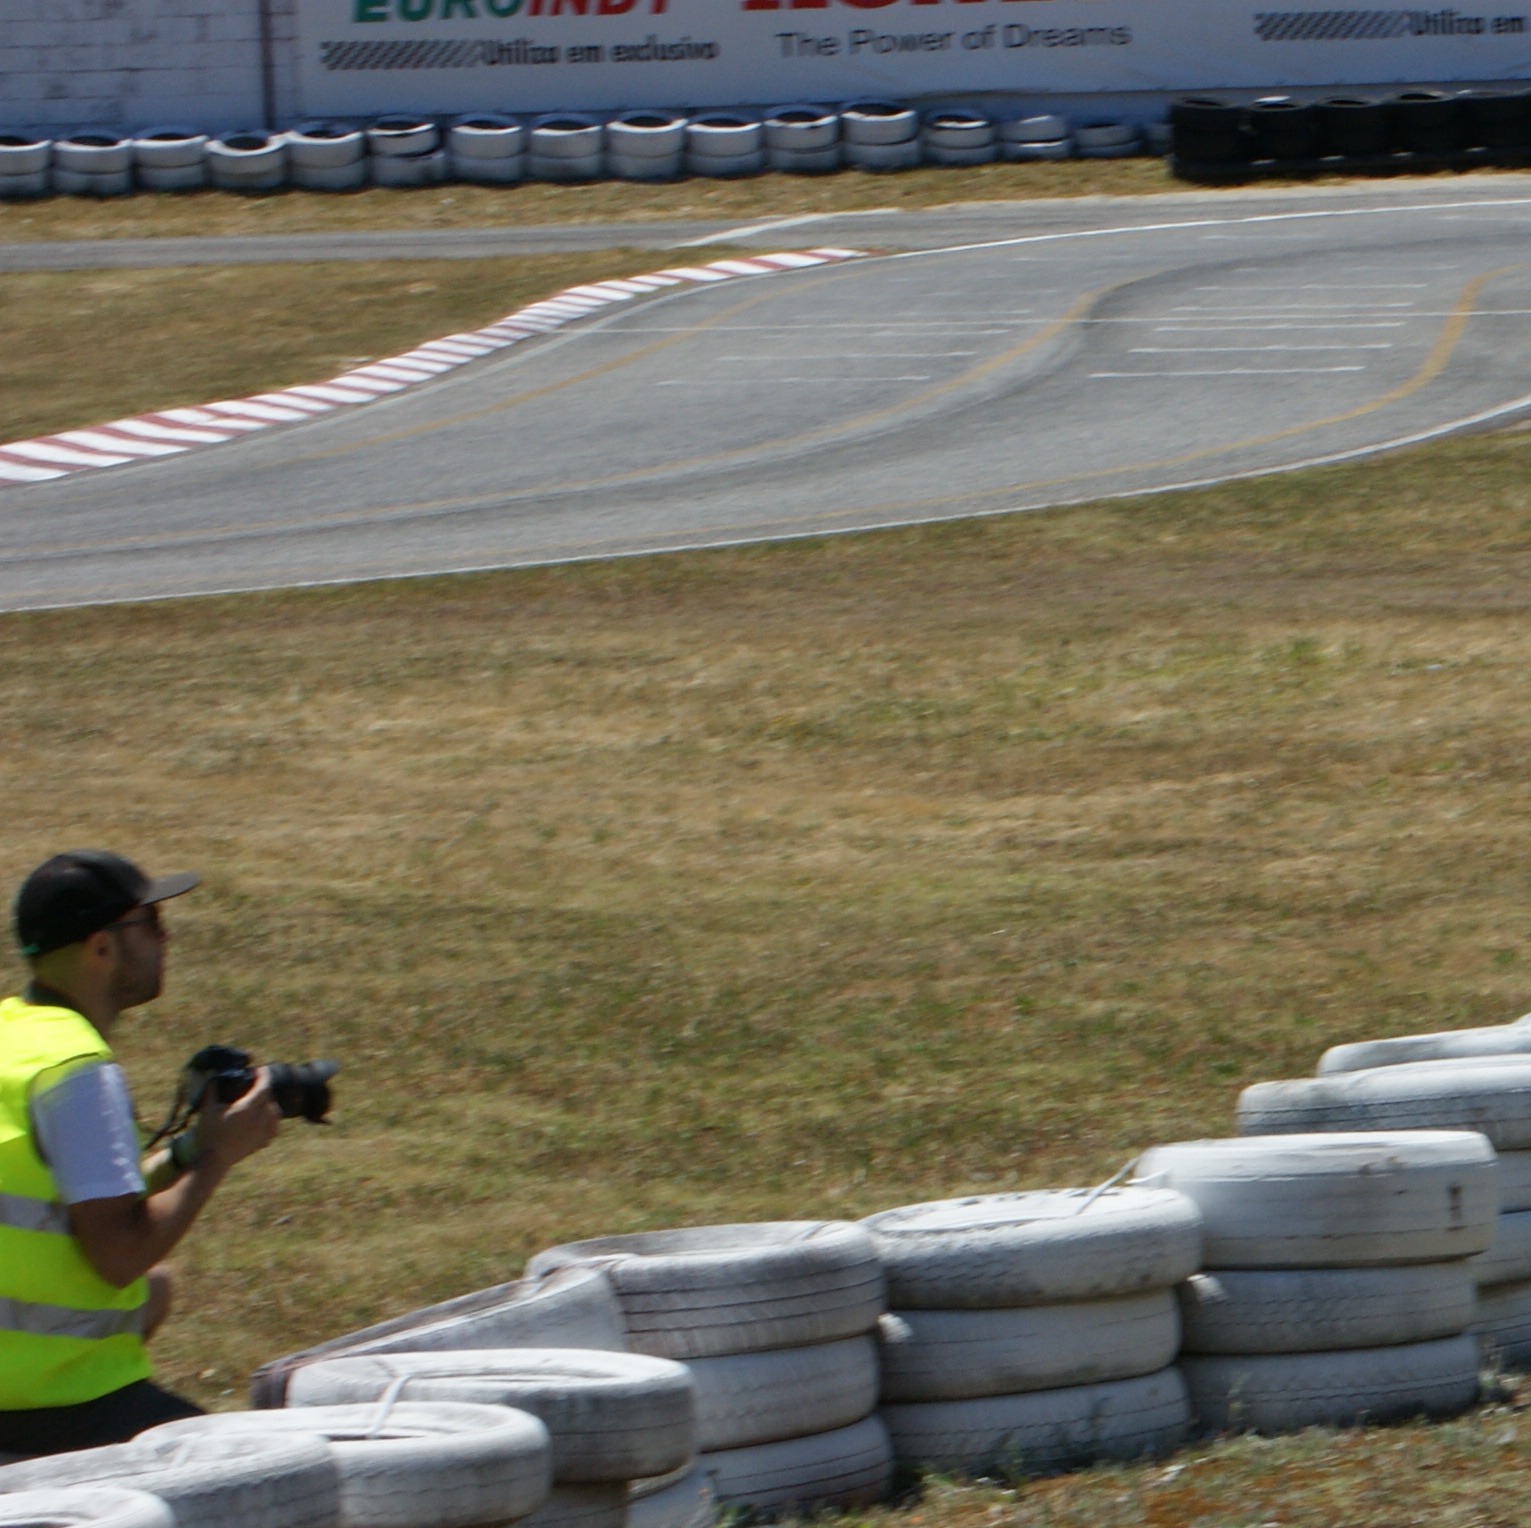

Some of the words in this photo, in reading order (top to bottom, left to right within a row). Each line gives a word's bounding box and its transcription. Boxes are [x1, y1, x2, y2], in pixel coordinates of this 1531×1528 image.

[567, 43, 602, 63] em
[611, 35, 720, 62] exclusivo
[776, 31, 839, 57] The
[849, 29, 955, 56] Power
[961, 24, 998, 50] of
[1005, 23, 1132, 49] Dreams
